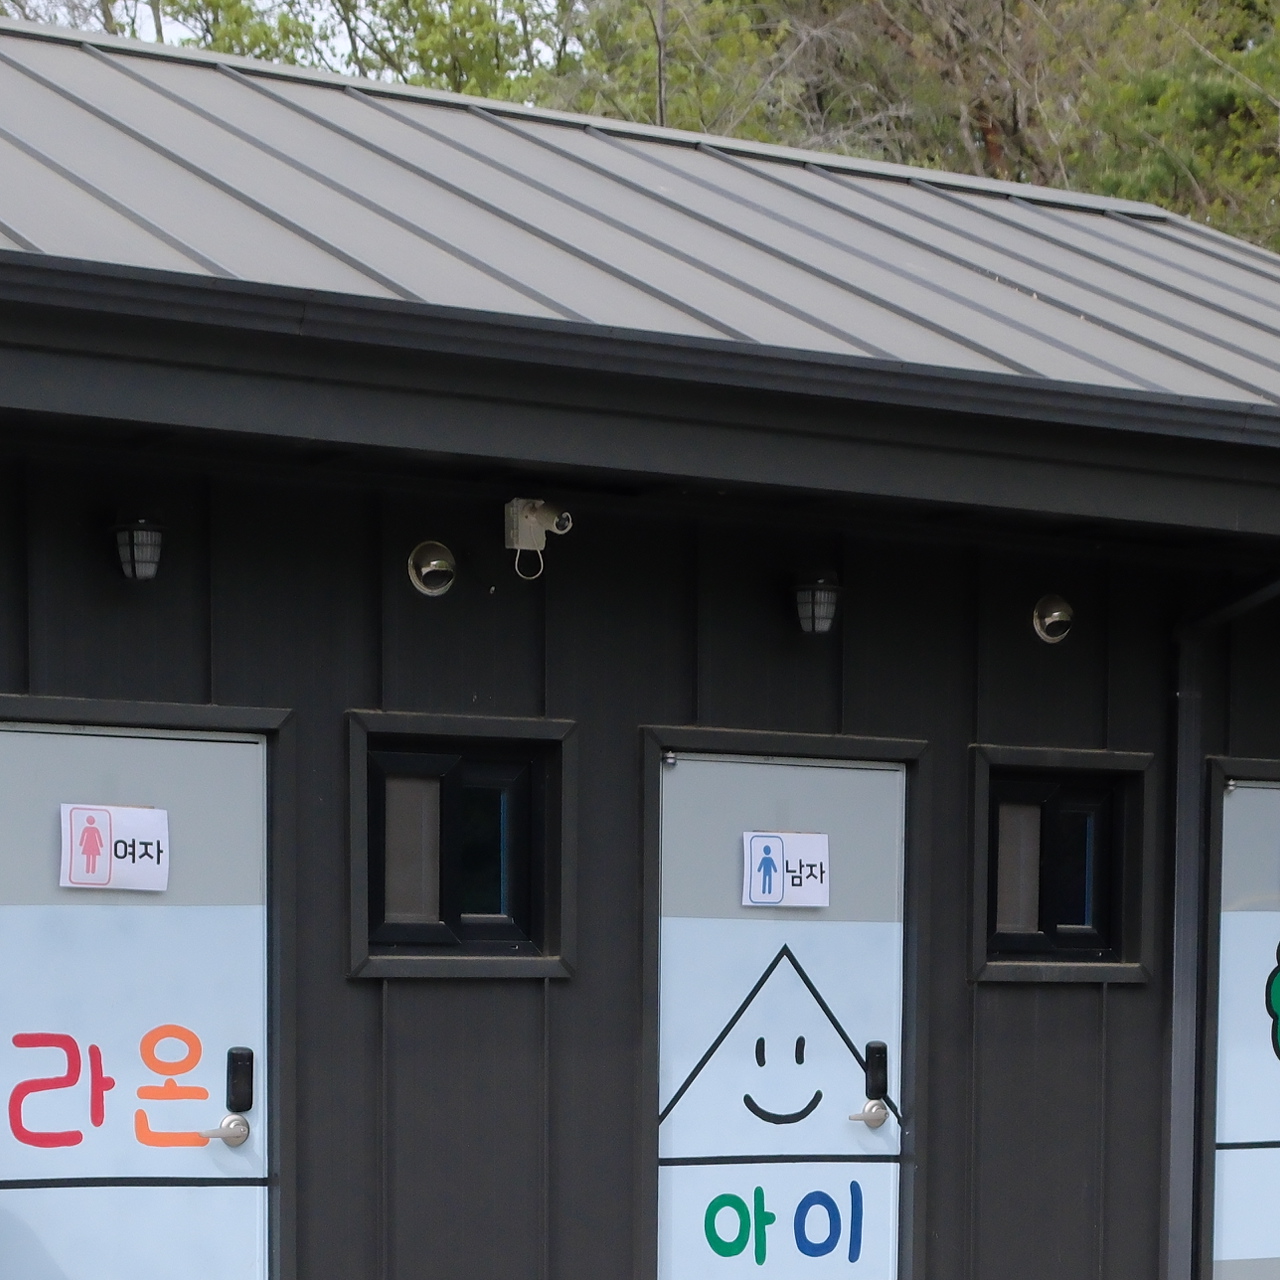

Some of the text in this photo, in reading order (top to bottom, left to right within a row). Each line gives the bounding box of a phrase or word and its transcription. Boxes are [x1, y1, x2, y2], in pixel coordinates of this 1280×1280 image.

[113, 838, 164, 865] 여자
[785, 858, 826, 887] 남자
[8, 1023, 210, 1148] 라온
[704, 1180, 864, 1266] 아이
